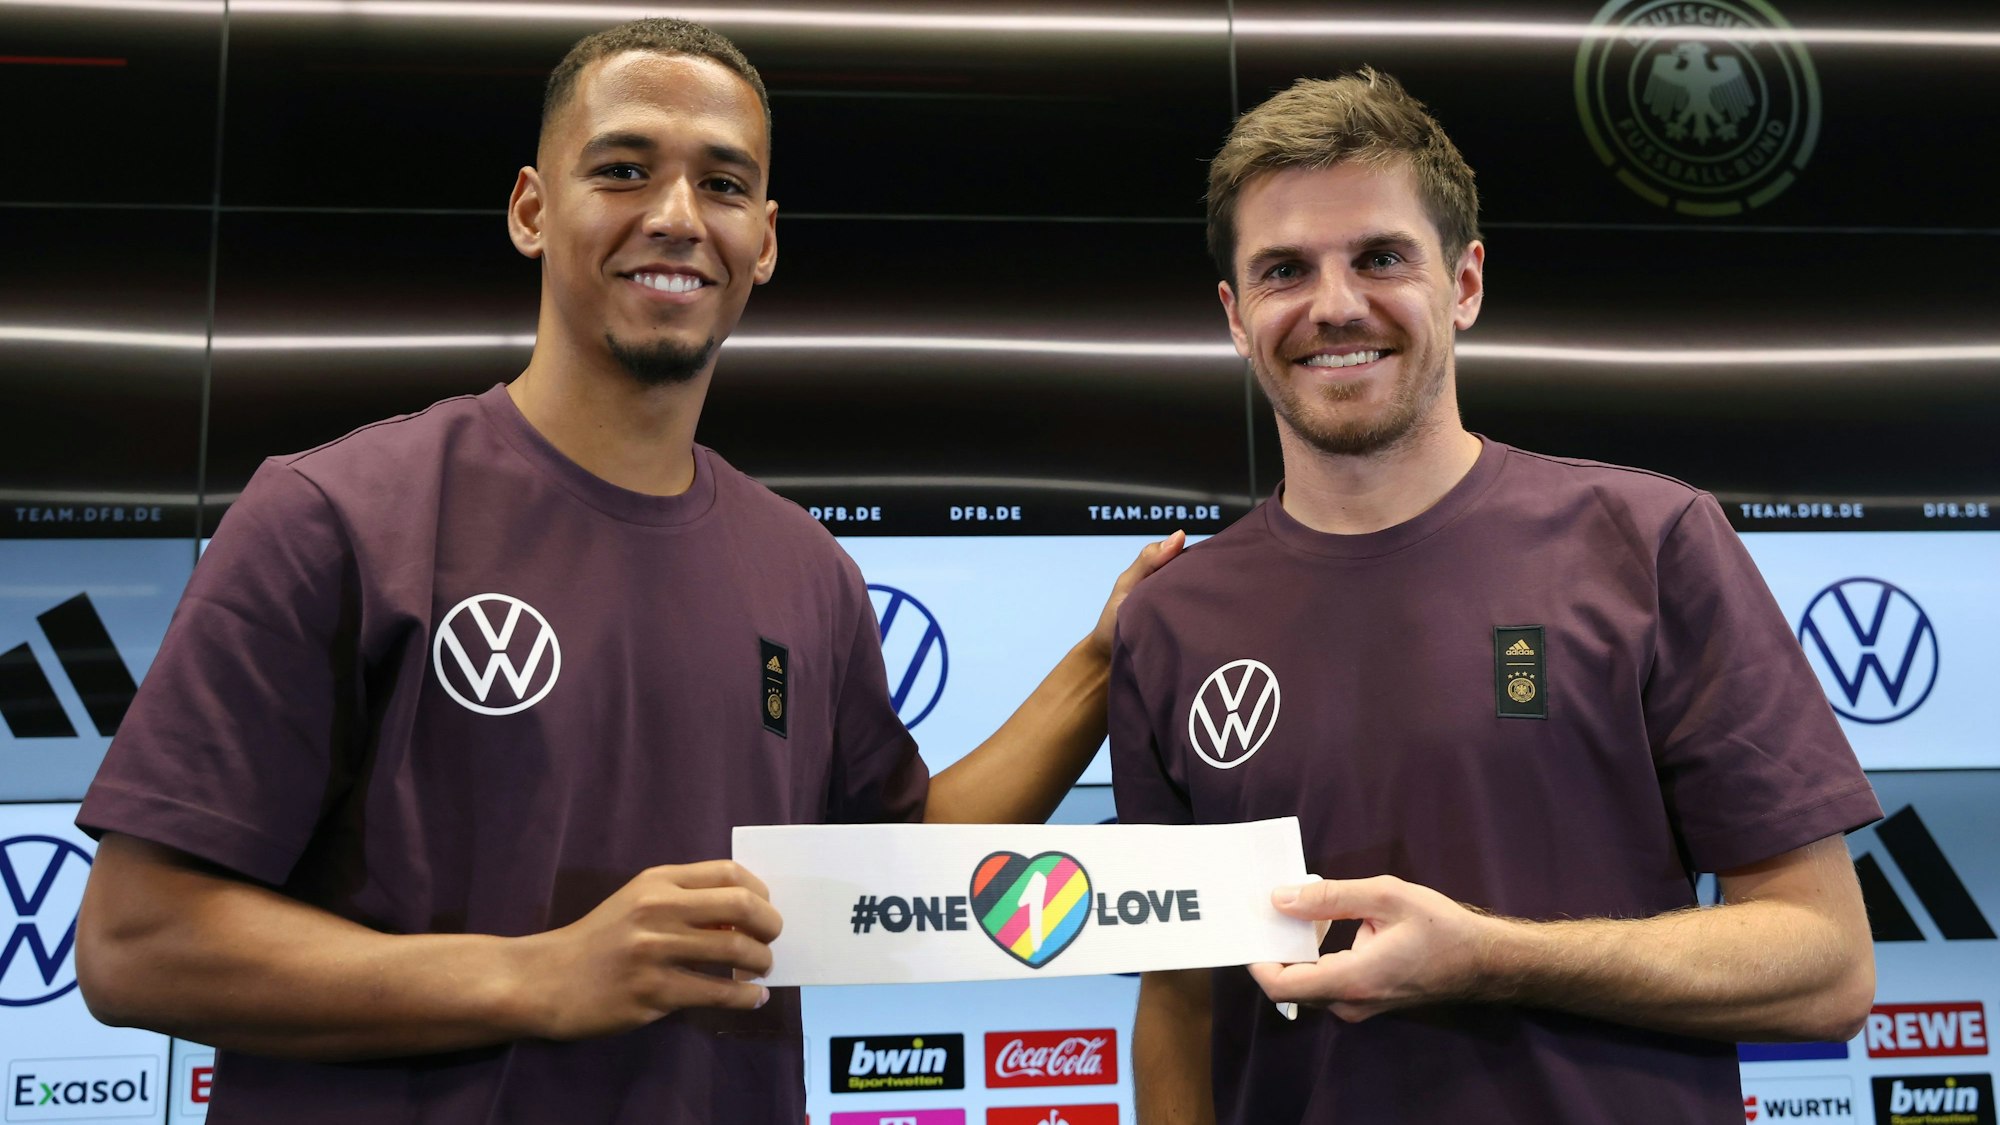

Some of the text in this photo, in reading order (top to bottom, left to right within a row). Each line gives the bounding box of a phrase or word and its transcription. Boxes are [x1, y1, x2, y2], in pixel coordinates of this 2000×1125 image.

[15, 506, 162, 521] TEAM.DFB.DE
[950, 506, 1021, 521] DFB.DE
[1088, 505, 1220, 520] TEAM.DFB.DE
[1741, 504, 1864, 518] TEAM.DFB.DE
[1924, 503, 1990, 517] DFB.DE
[438, 595, 554, 705] VW
[1506, 648, 1534, 656] adidas
[1192, 660, 1279, 761] VW
[852, 871, 1200, 952] #ONE 1 LOVE
[1868, 1010, 1986, 1051] REWE
[848, 1037, 947, 1076] bwin
[995, 1037, 1107, 1078] Coca-Cola
[14, 1070, 148, 1106] Exasol
[1889, 1077, 1979, 1115] bwin
